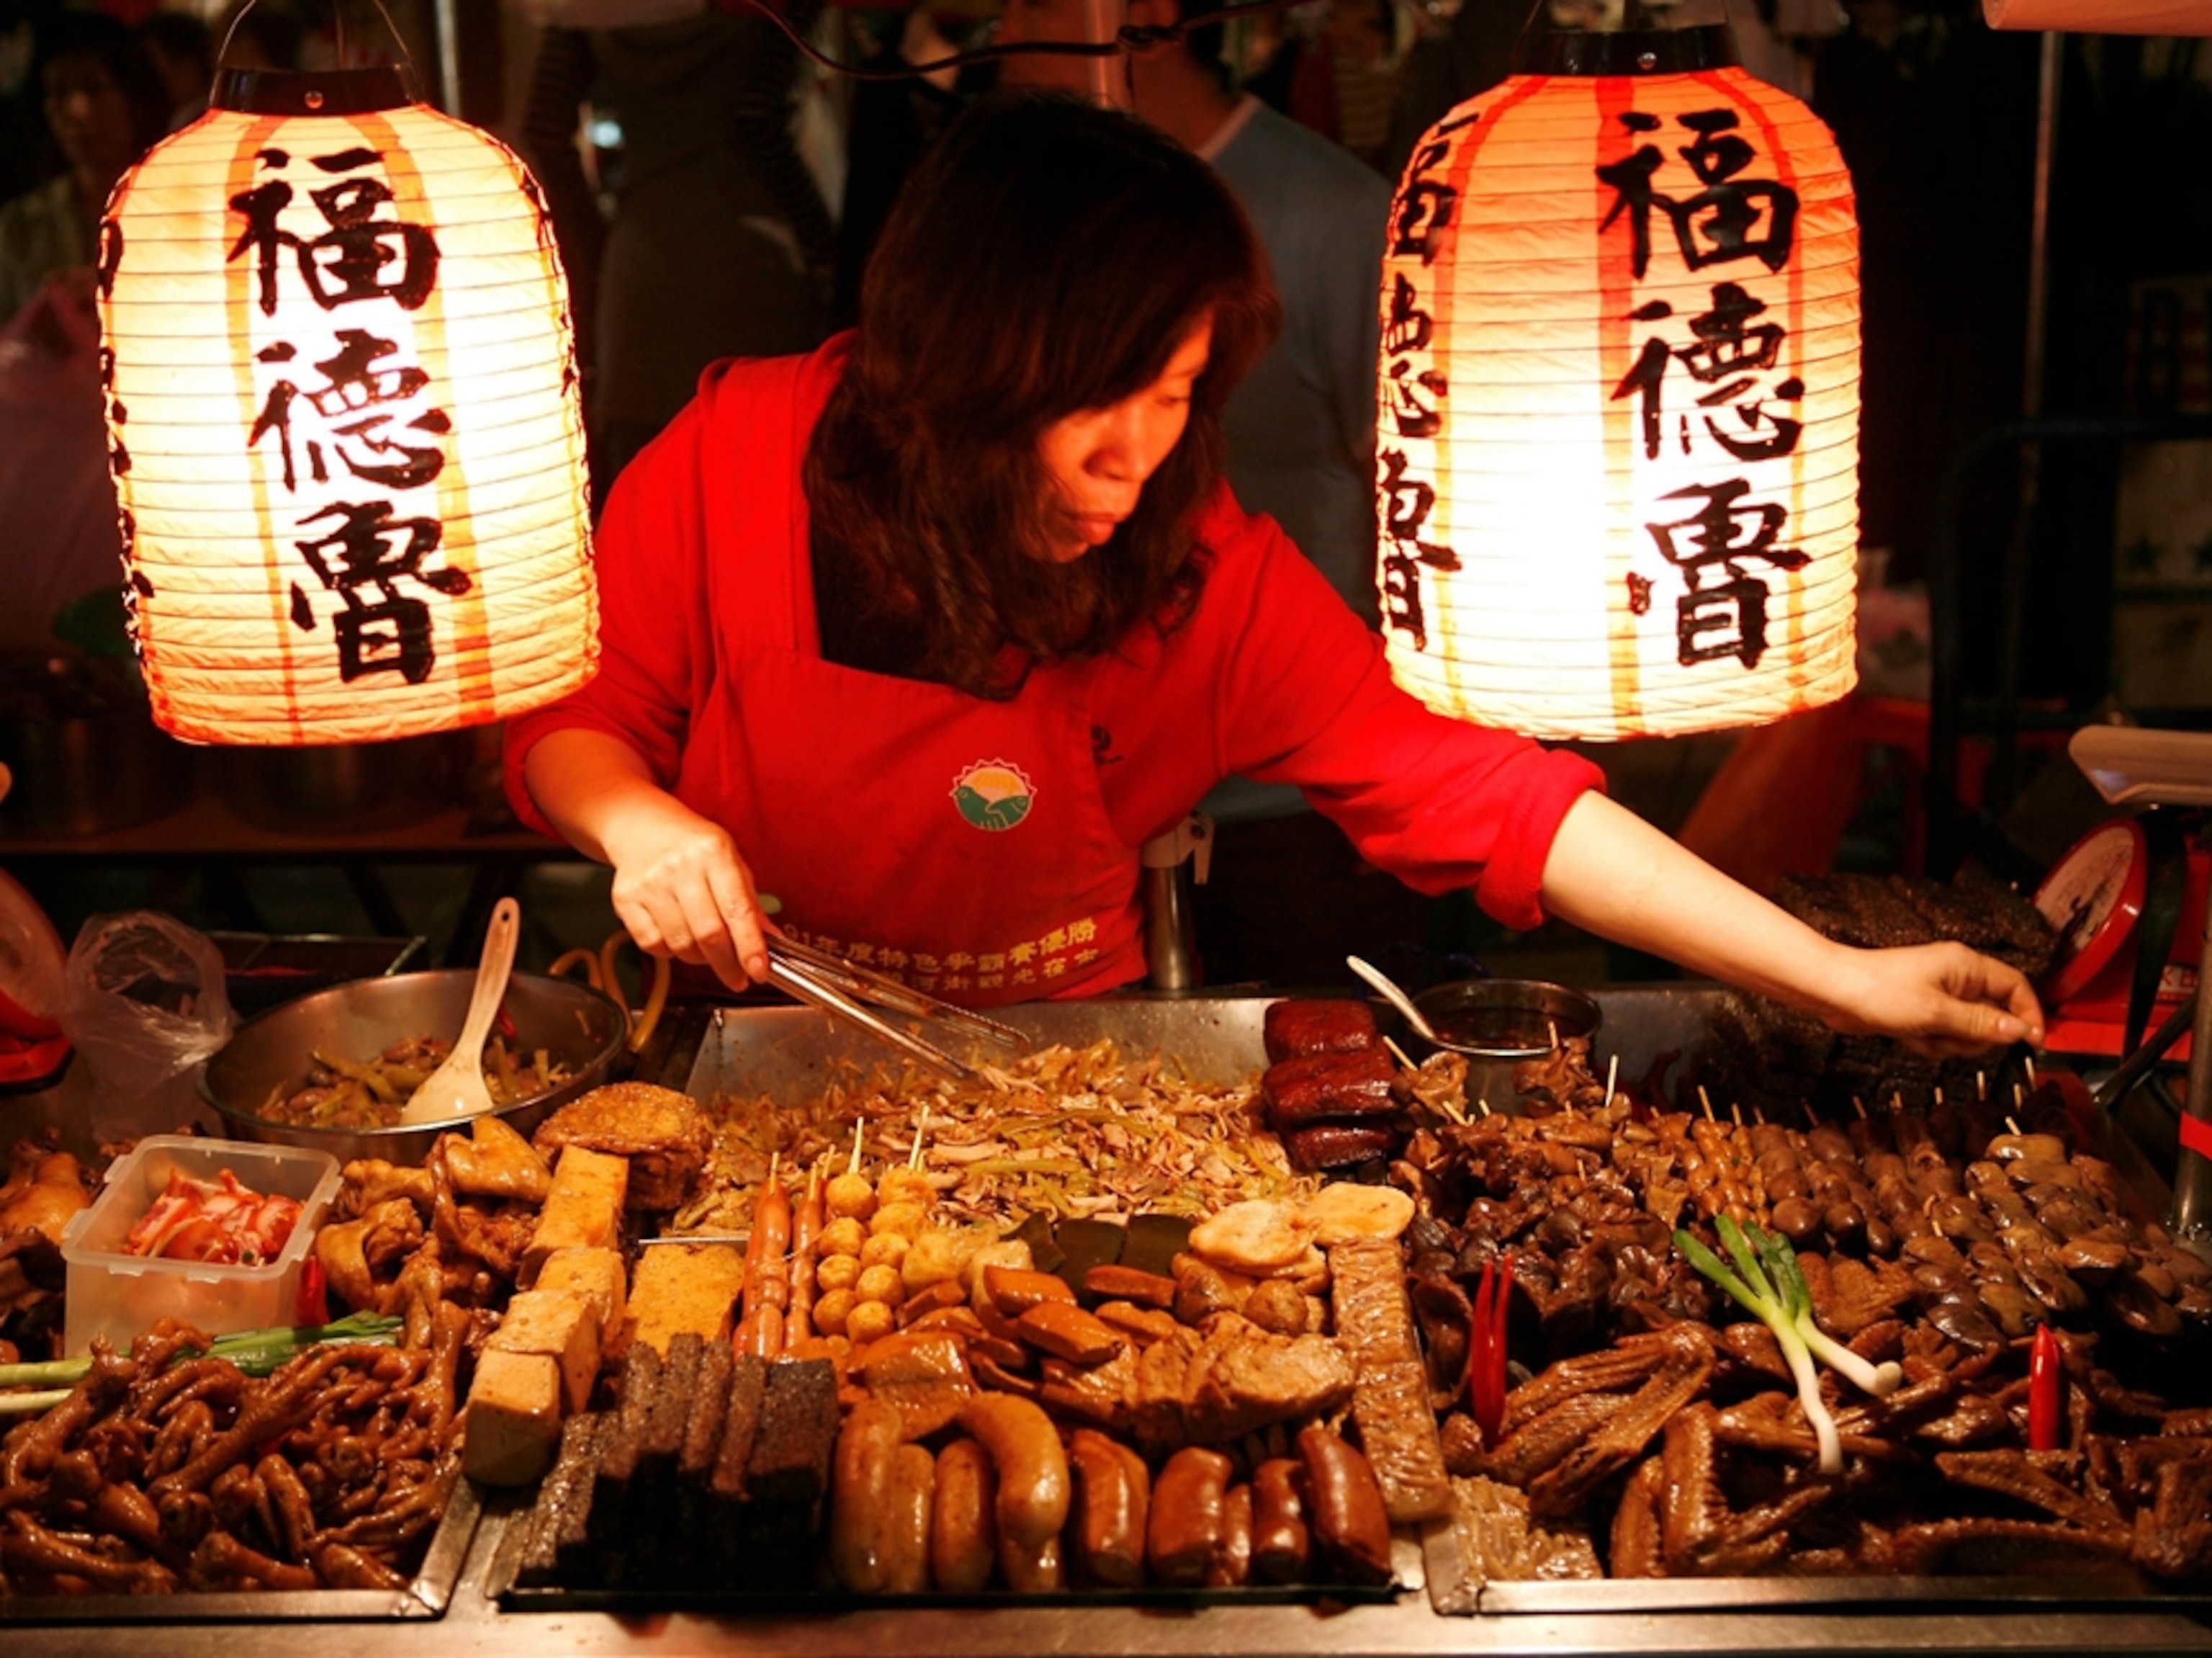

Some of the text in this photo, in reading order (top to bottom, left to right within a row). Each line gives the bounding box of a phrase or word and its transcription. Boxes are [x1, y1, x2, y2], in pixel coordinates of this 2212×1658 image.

[227, 148, 472, 685] 福德魯
[1596, 109, 1812, 670] 福德魯
